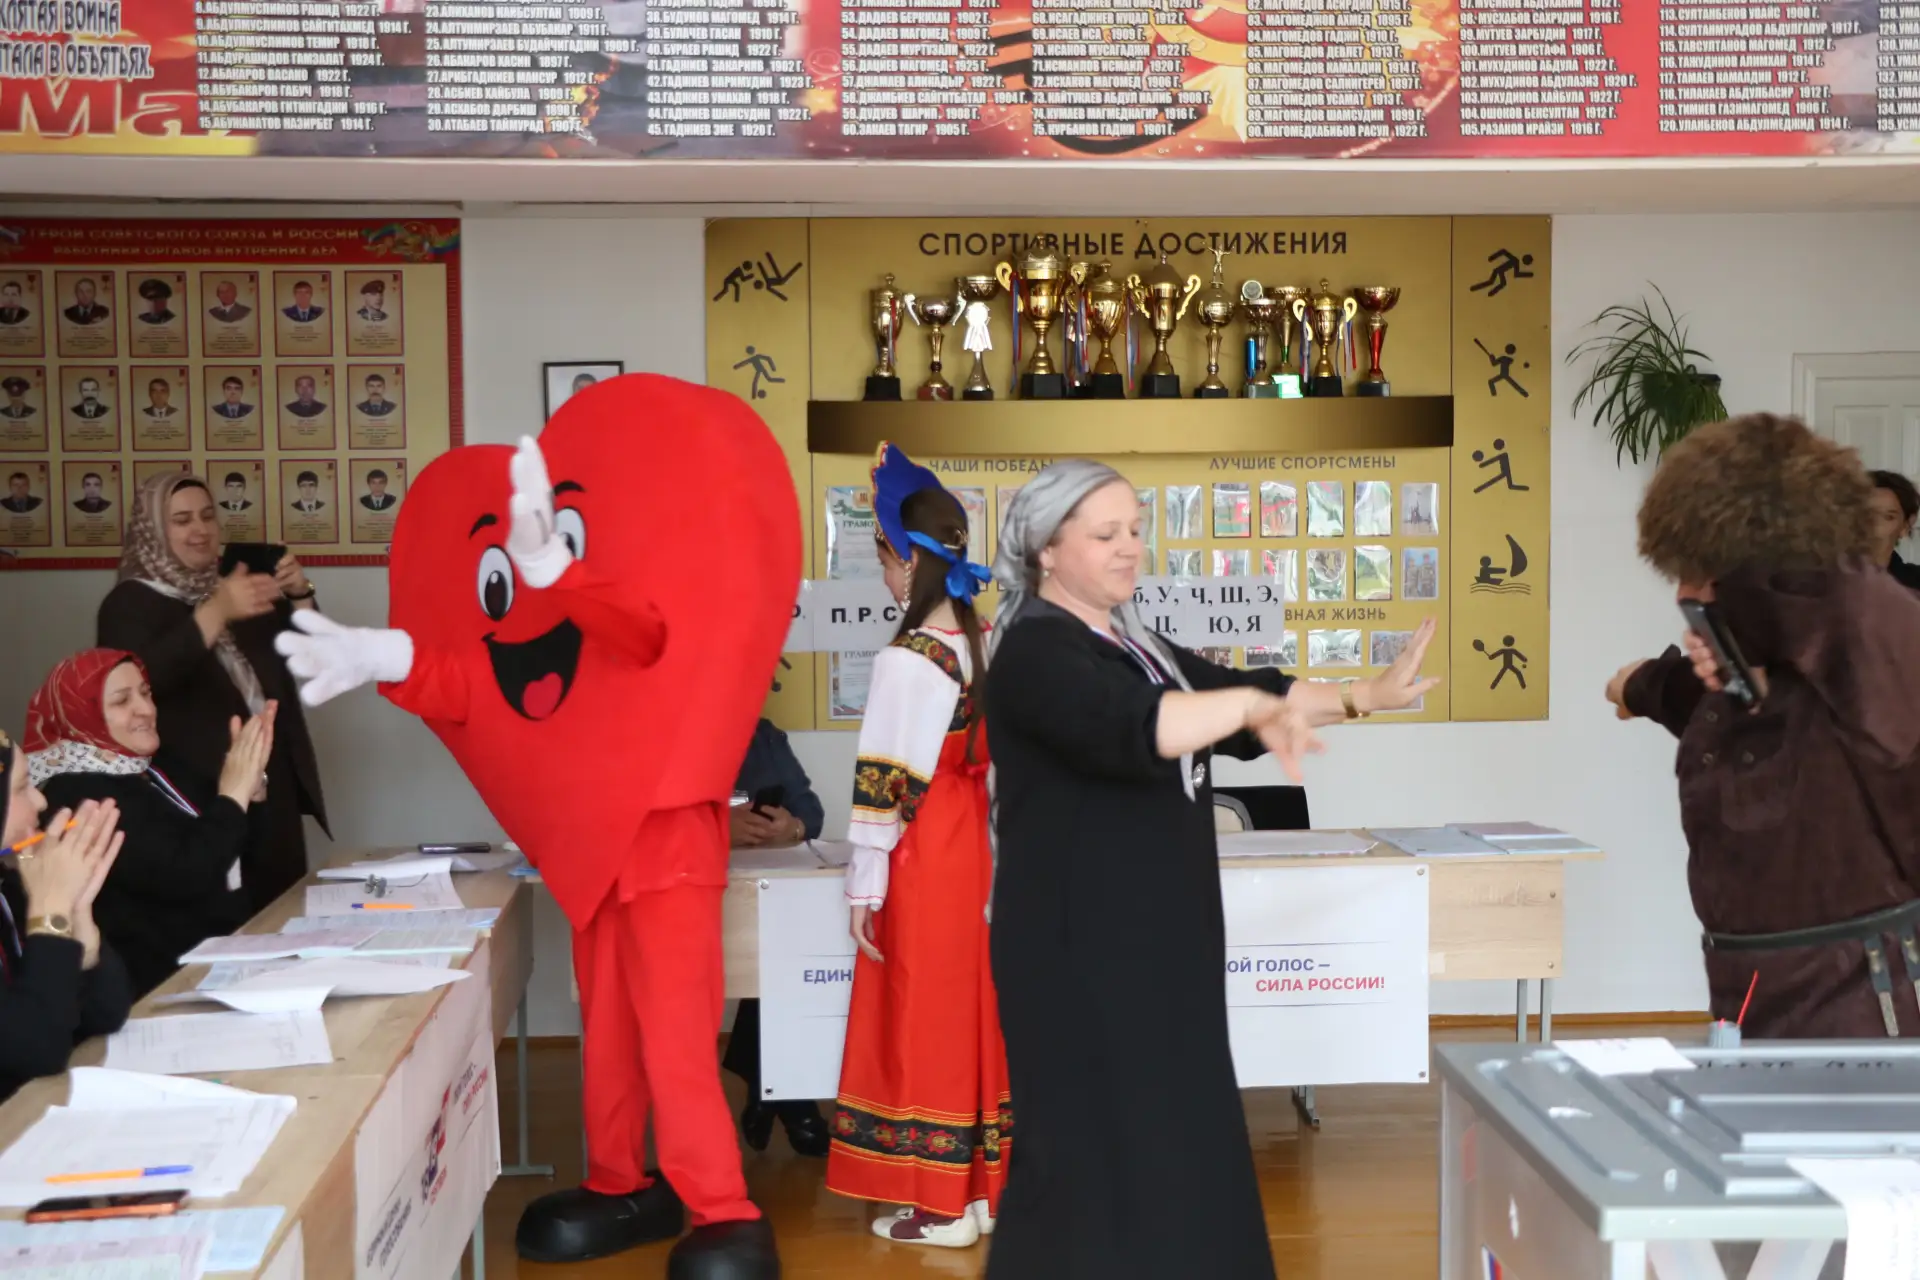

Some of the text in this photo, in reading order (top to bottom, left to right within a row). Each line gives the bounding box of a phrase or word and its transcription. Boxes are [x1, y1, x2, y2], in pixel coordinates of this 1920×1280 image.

[1134, 231, 1348, 259] ДОСТИЖЕНИЯ
[929, 460, 979, 472] ЧАШИ
[1209, 456, 1396, 470] ЛУЧШИЕ СПОРТСМЕНЫ
[1158, 586, 1179, 604] У,
[1192, 586, 1278, 604] Ч, Ш, Э,
[1332, 608, 1386, 620] ЖИЗНЬ
[1209, 615, 1262, 636] Ю, Я
[1256, 958, 1314, 972] ГОЛОС
[1256, 976, 1385, 992] СИЛА РОССИИ!
